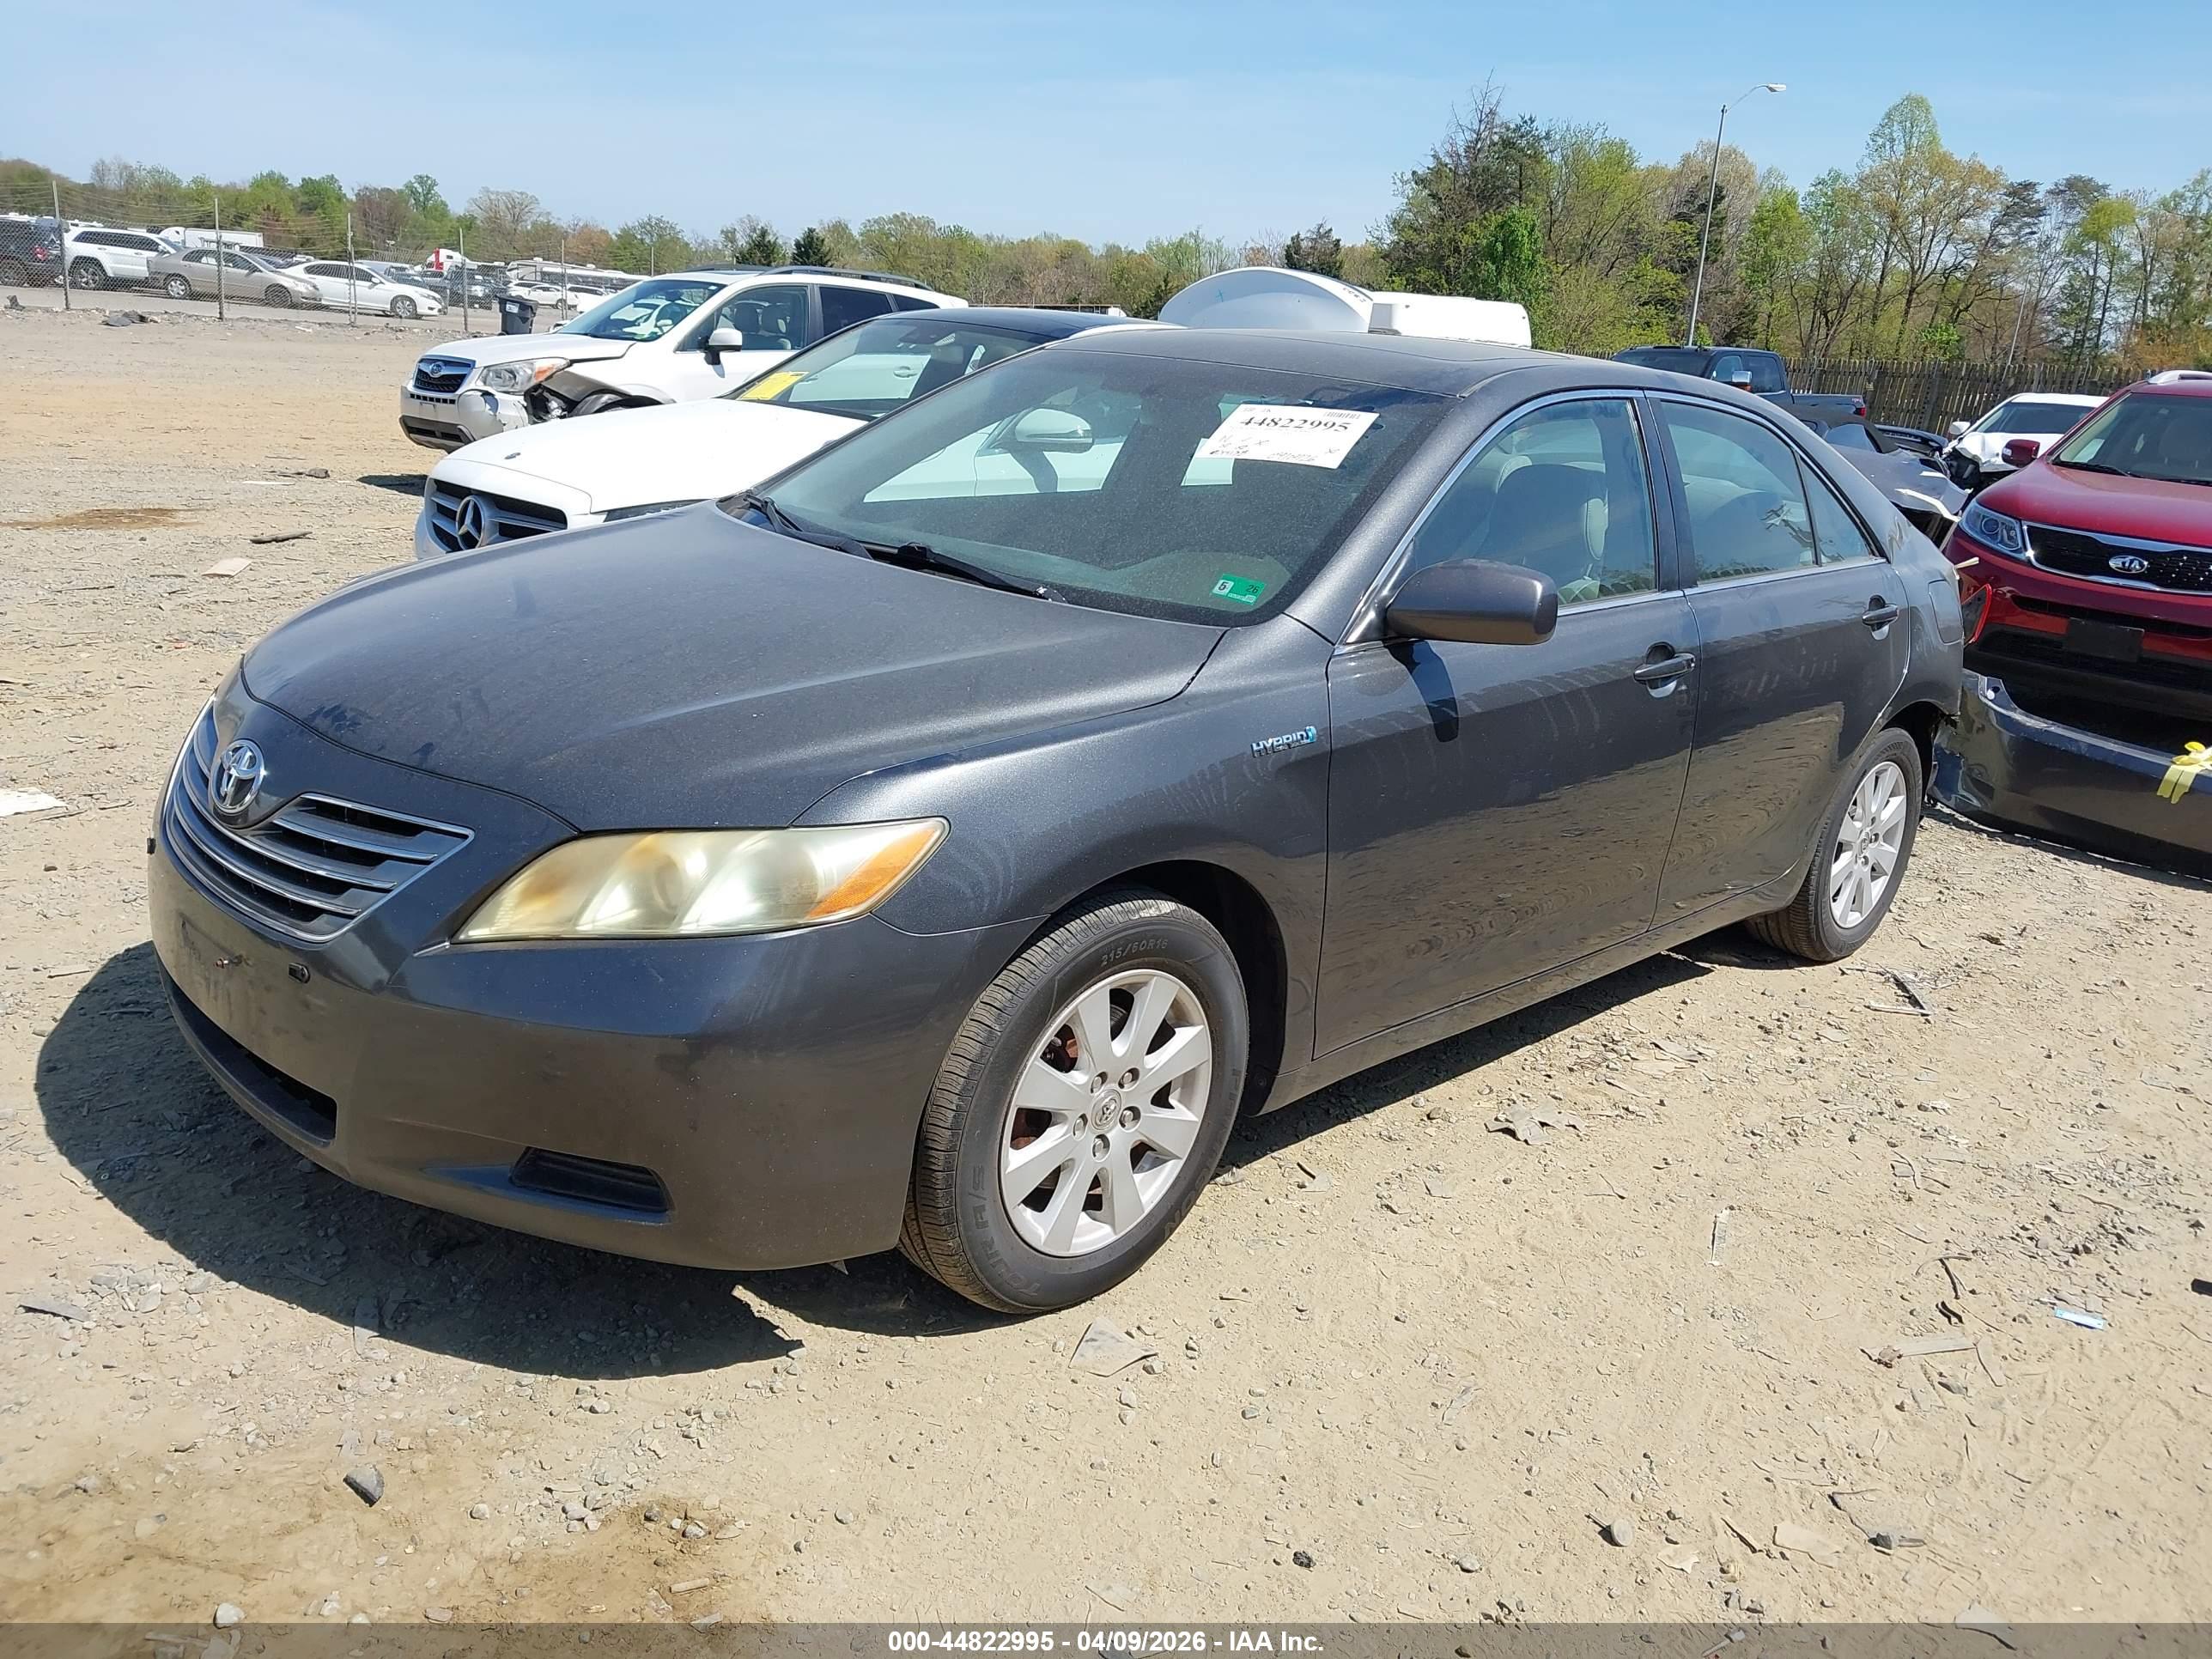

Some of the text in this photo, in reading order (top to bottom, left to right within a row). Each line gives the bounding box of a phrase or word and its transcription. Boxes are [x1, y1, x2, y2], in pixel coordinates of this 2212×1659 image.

[1240, 416, 1352, 433] 44822995
[1251, 729, 1312, 757] HYBRID
[1100, 938, 1169, 968] 215/60R16
[976, 1233, 1042, 1298] TOUR
